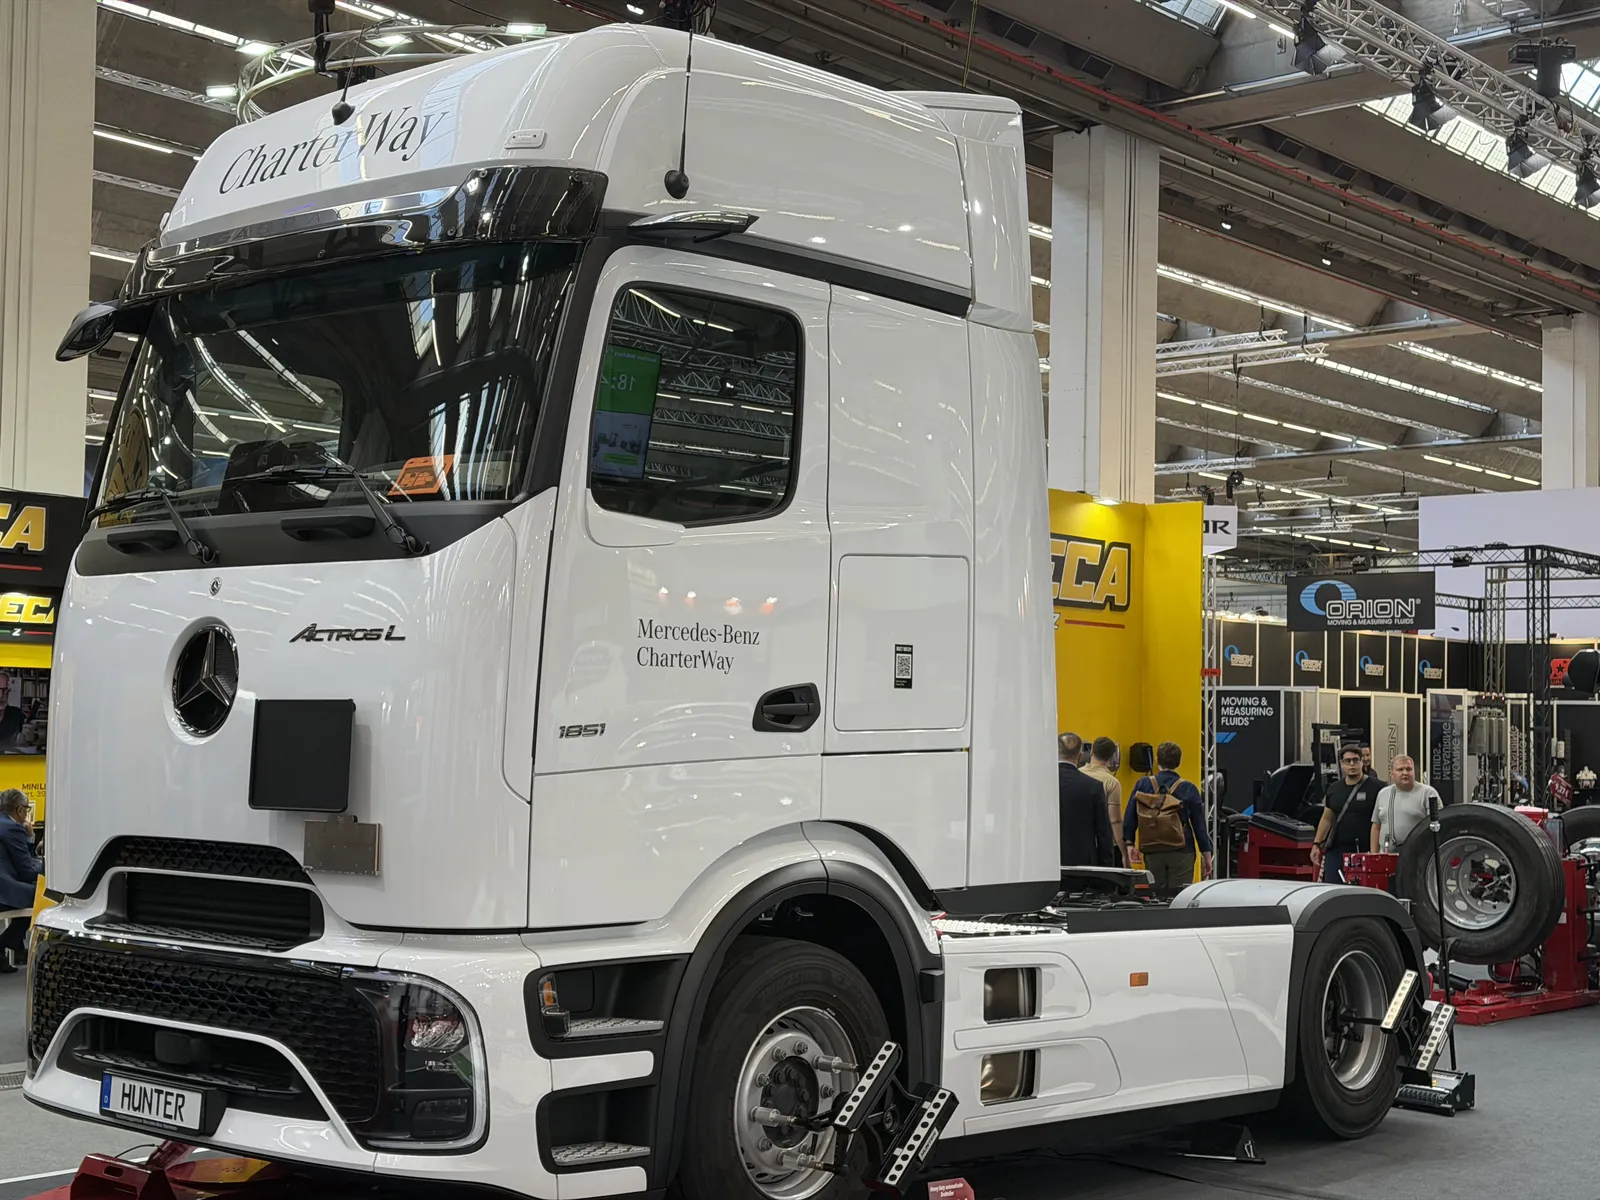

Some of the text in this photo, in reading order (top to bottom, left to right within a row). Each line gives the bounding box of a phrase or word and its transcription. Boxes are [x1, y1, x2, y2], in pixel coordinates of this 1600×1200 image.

[219, 105, 450, 195] CharterWay
[1358, 618, 1393, 626] MEASURING
[385, 625, 406, 641] L
[637, 618, 760, 645] Mercedes-Benz
[636, 646, 734, 675] CharterWay
[1221, 696, 1268, 706] MOVING &
[1221, 707, 1274, 716] MEASURING
[558, 722, 606, 739] 1851
[121, 1082, 186, 1122] HUNTER
